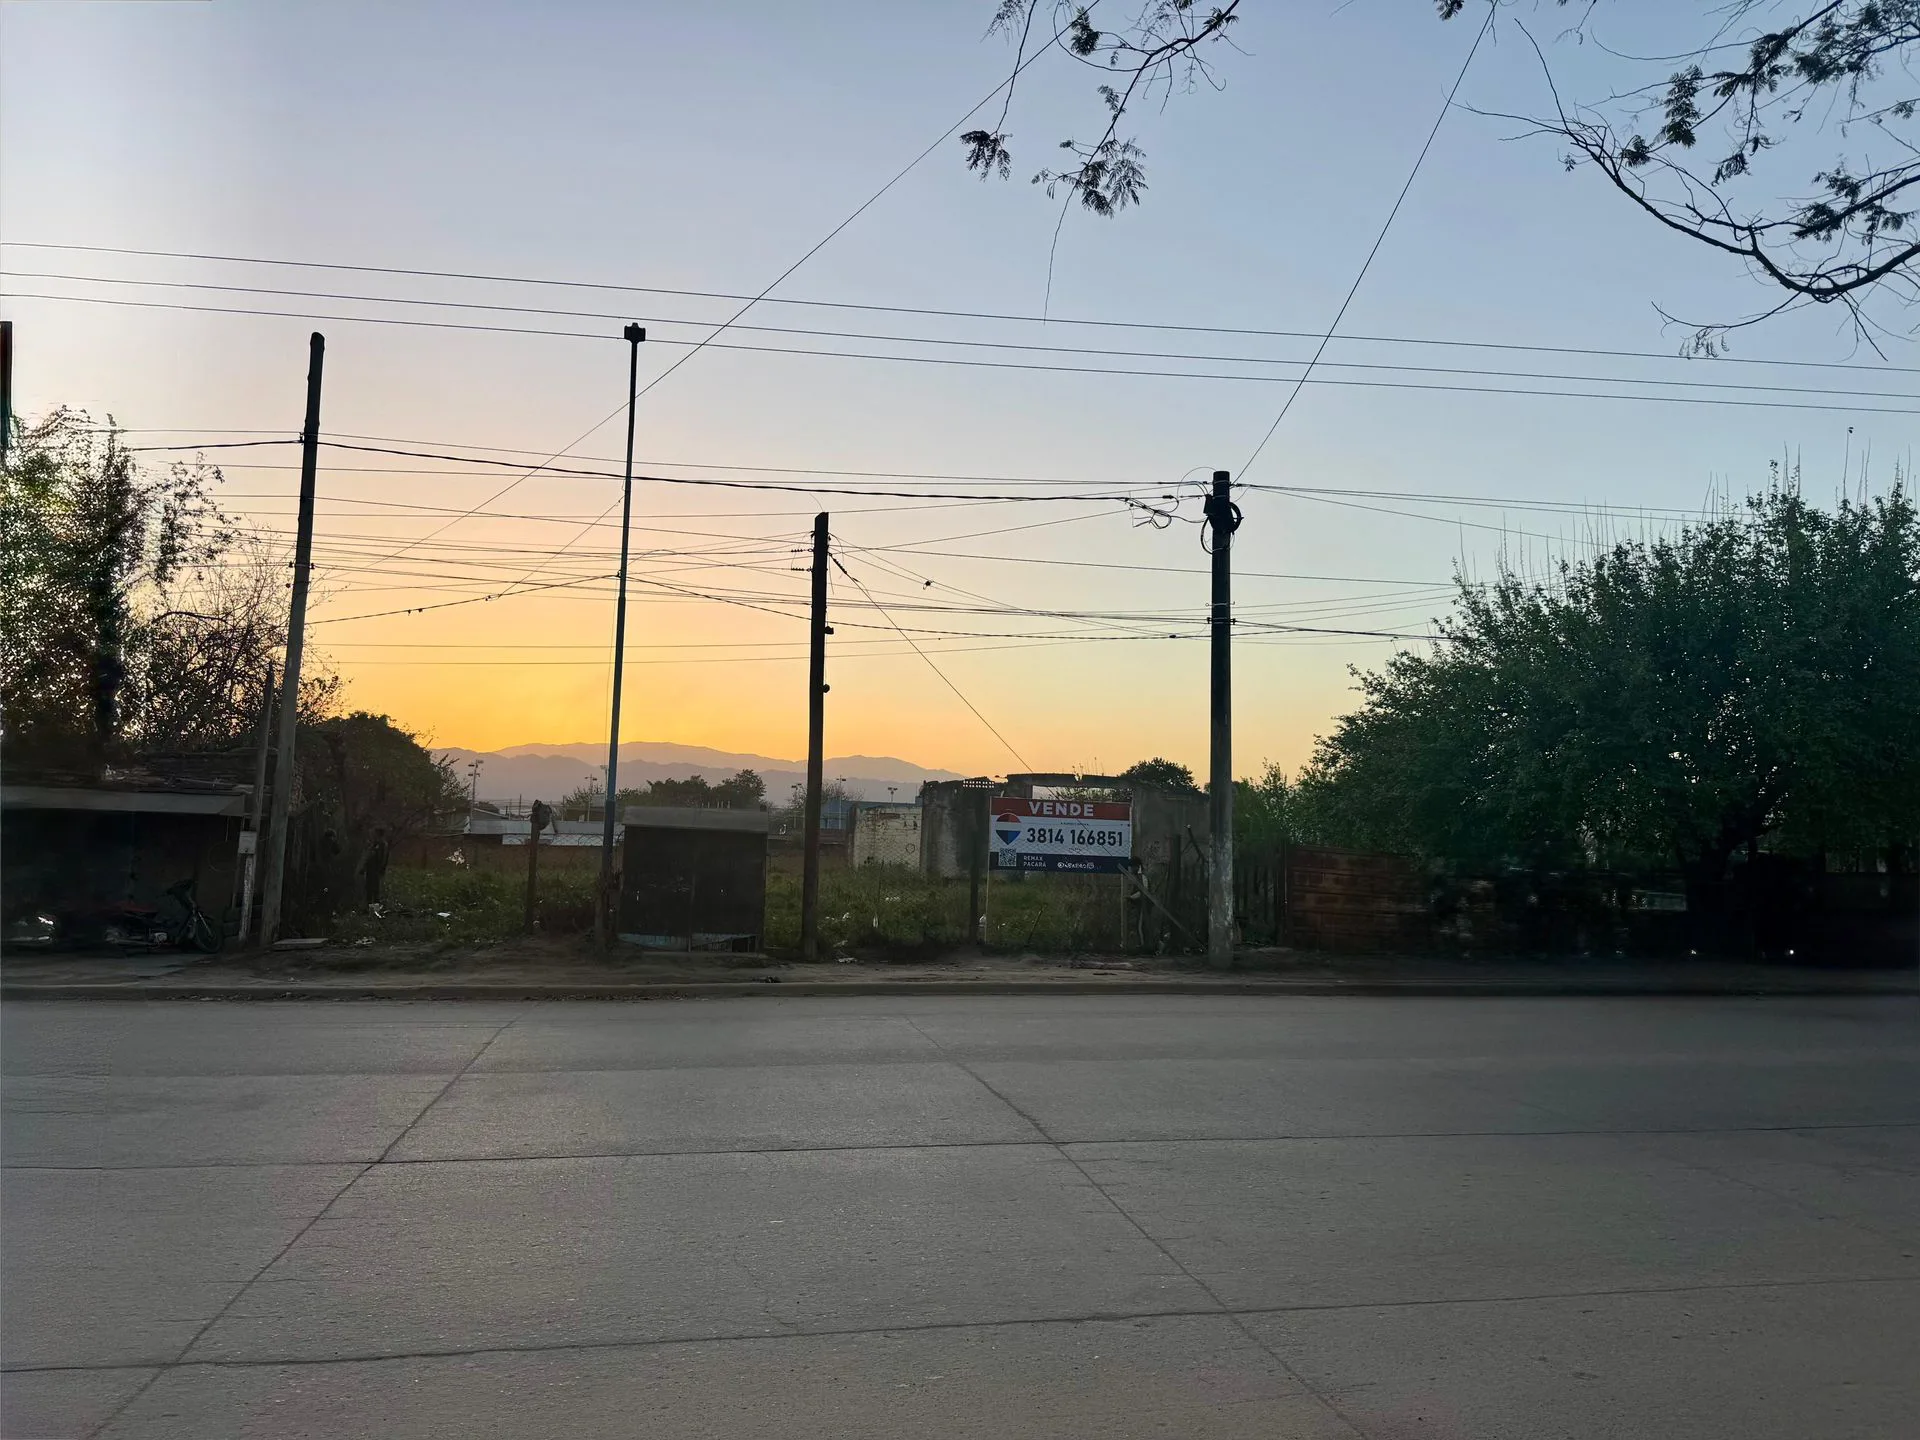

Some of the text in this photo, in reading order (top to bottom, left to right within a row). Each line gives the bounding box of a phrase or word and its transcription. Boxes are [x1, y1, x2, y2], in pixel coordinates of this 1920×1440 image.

[1029, 801, 1094, 816] VENDE
[1026, 828, 1123, 846] 3814 166851
